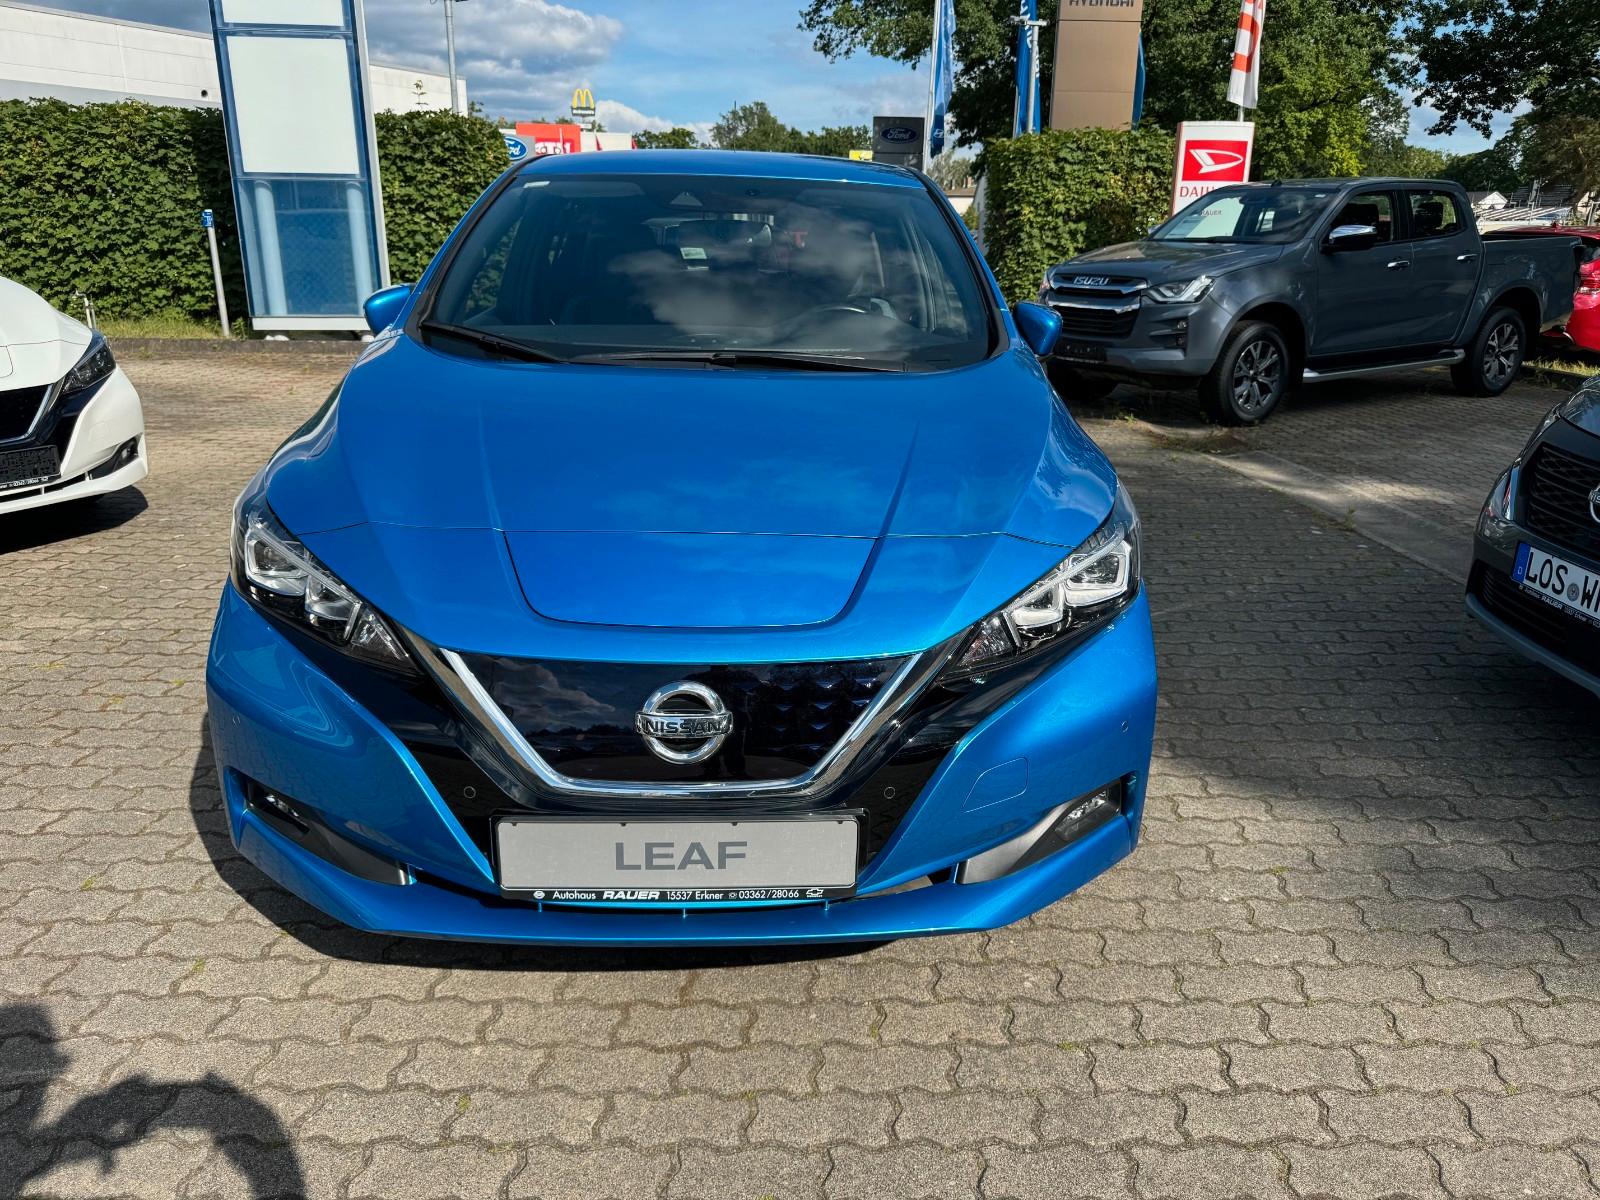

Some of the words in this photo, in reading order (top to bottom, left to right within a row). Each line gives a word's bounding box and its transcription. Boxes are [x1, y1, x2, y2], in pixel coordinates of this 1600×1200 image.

[1073, 276, 1109, 286] ISUZU
[1525, 551, 1568, 595] LOS
[643, 720, 721, 733] NISSAN
[615, 841, 748, 870] LEAF
[552, 890, 596, 900] Autohaus
[602, 890, 660, 900] RAUER
[666, 891, 692, 900] 15537
[695, 891, 724, 900] Erkner
[739, 890, 800, 899] 03362/28066
